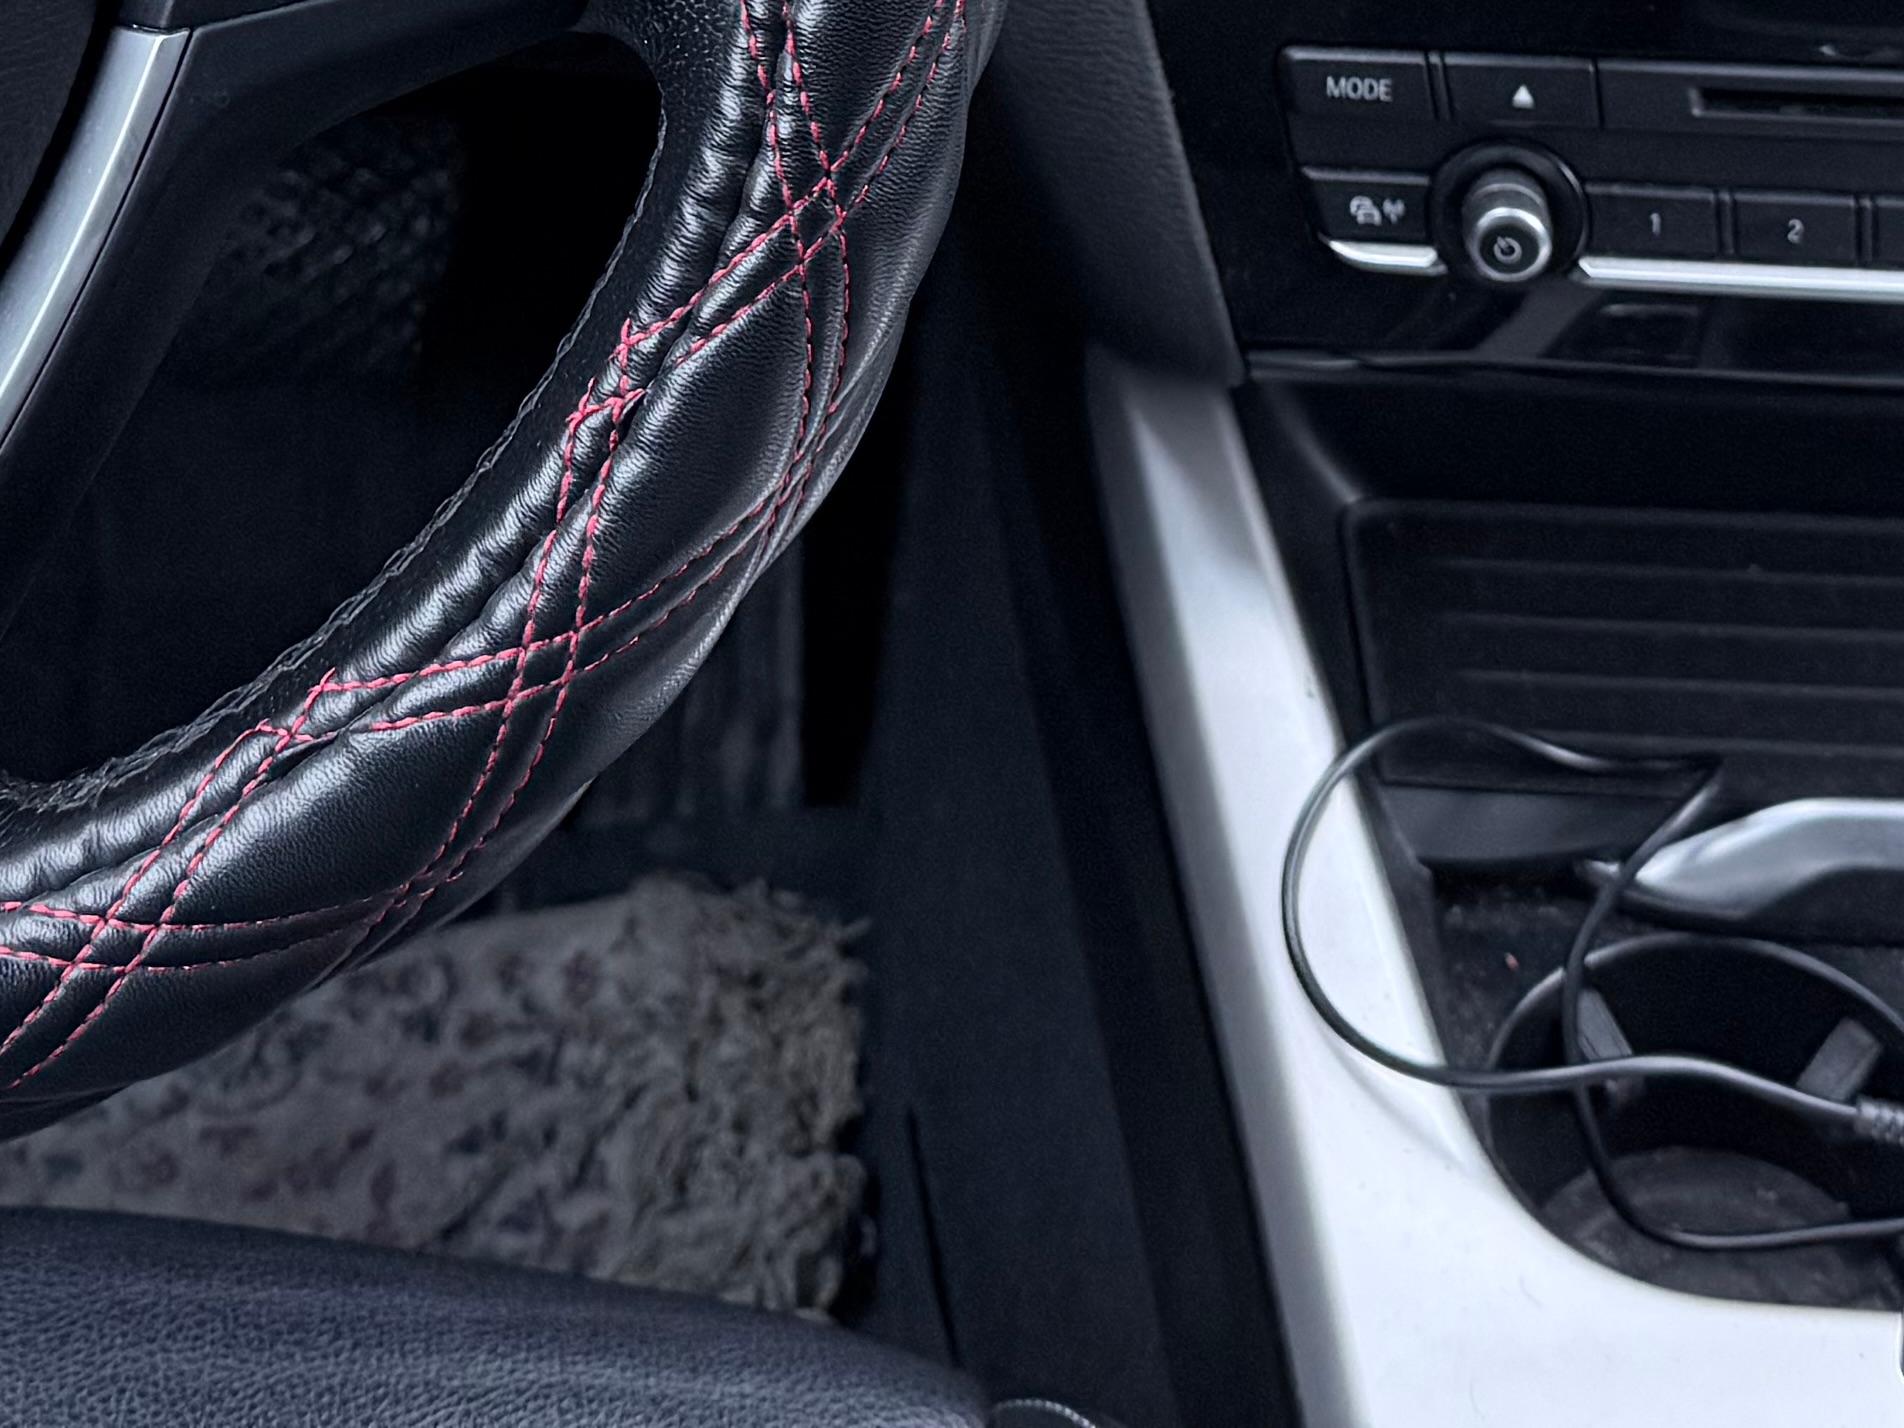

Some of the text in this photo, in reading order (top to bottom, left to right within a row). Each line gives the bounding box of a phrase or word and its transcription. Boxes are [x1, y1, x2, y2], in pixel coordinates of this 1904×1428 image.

[1326, 75, 1393, 102] MODE
[1649, 212, 1662, 236] 1
[1787, 219, 1805, 244] 2
